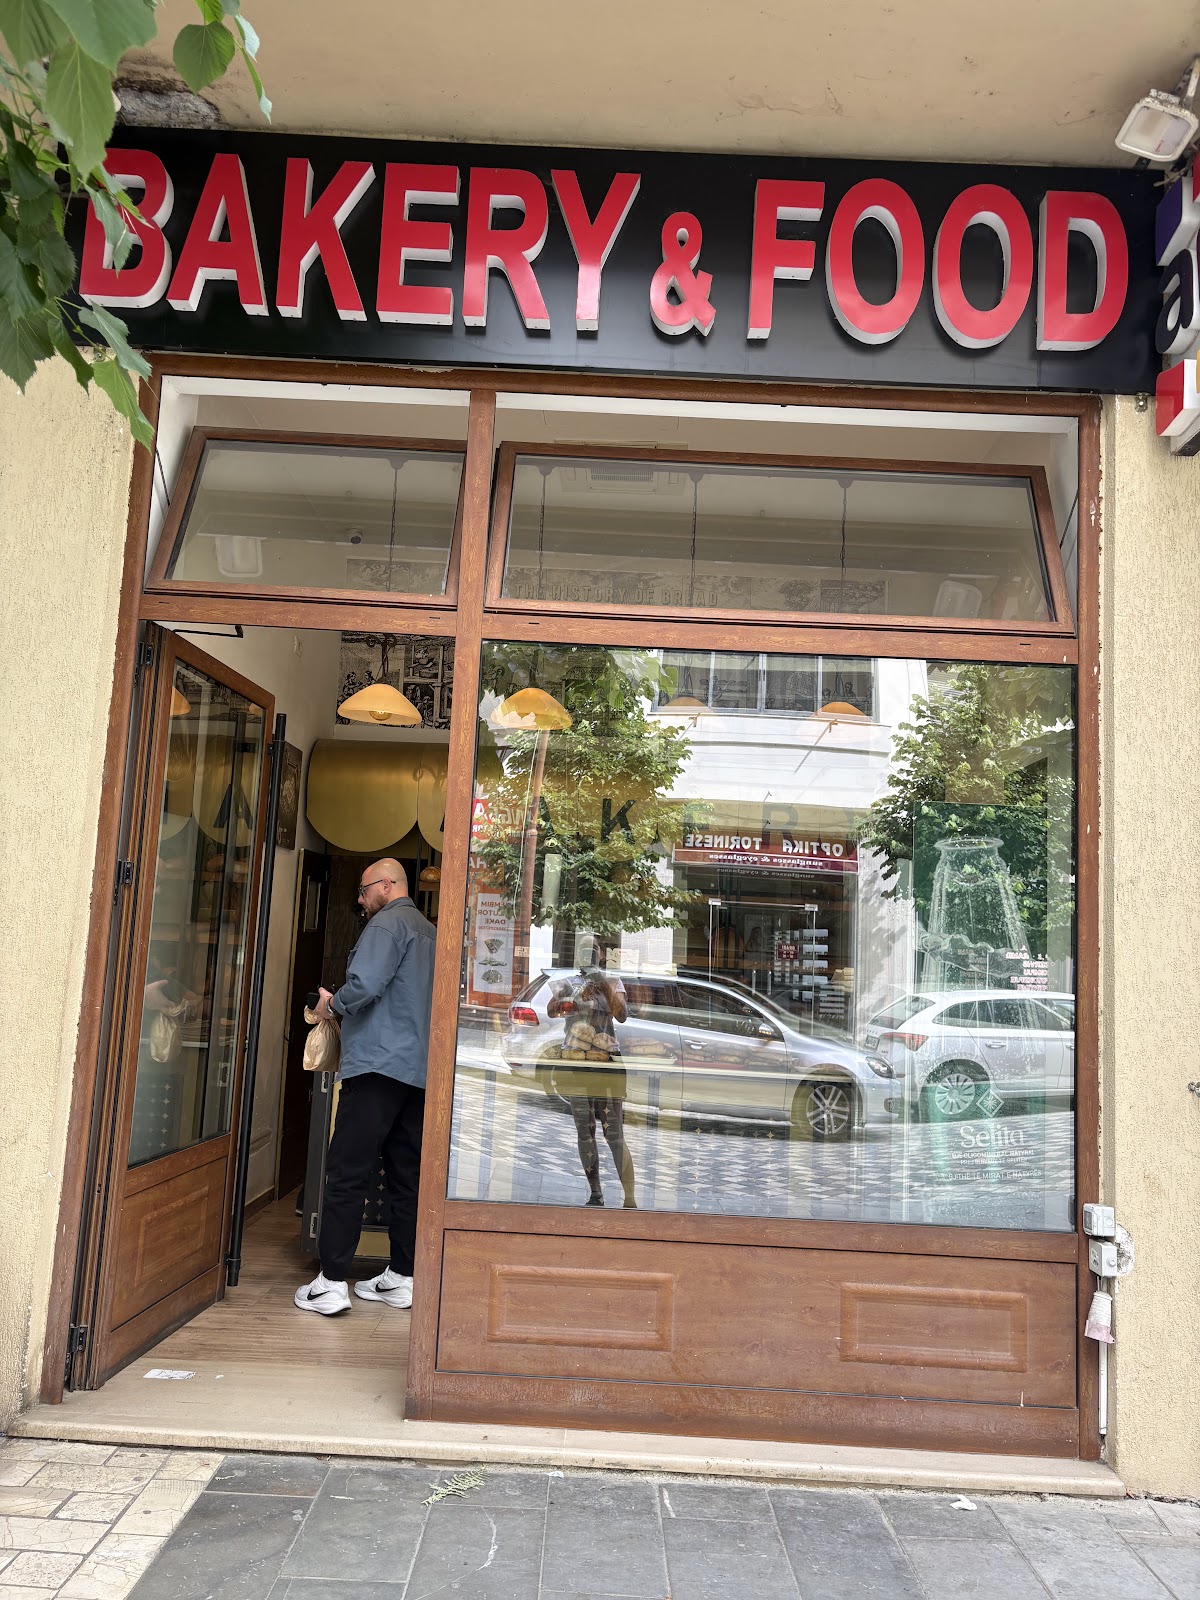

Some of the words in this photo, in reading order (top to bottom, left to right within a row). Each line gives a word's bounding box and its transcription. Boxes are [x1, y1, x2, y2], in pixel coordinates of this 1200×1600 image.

[79, 147, 641, 332] BAKERY
[650, 211, 716, 337] &
[746, 178, 1129, 352] FOOD
[551, 584, 626, 604] HISTORY
[634, 587, 655, 605] OF
